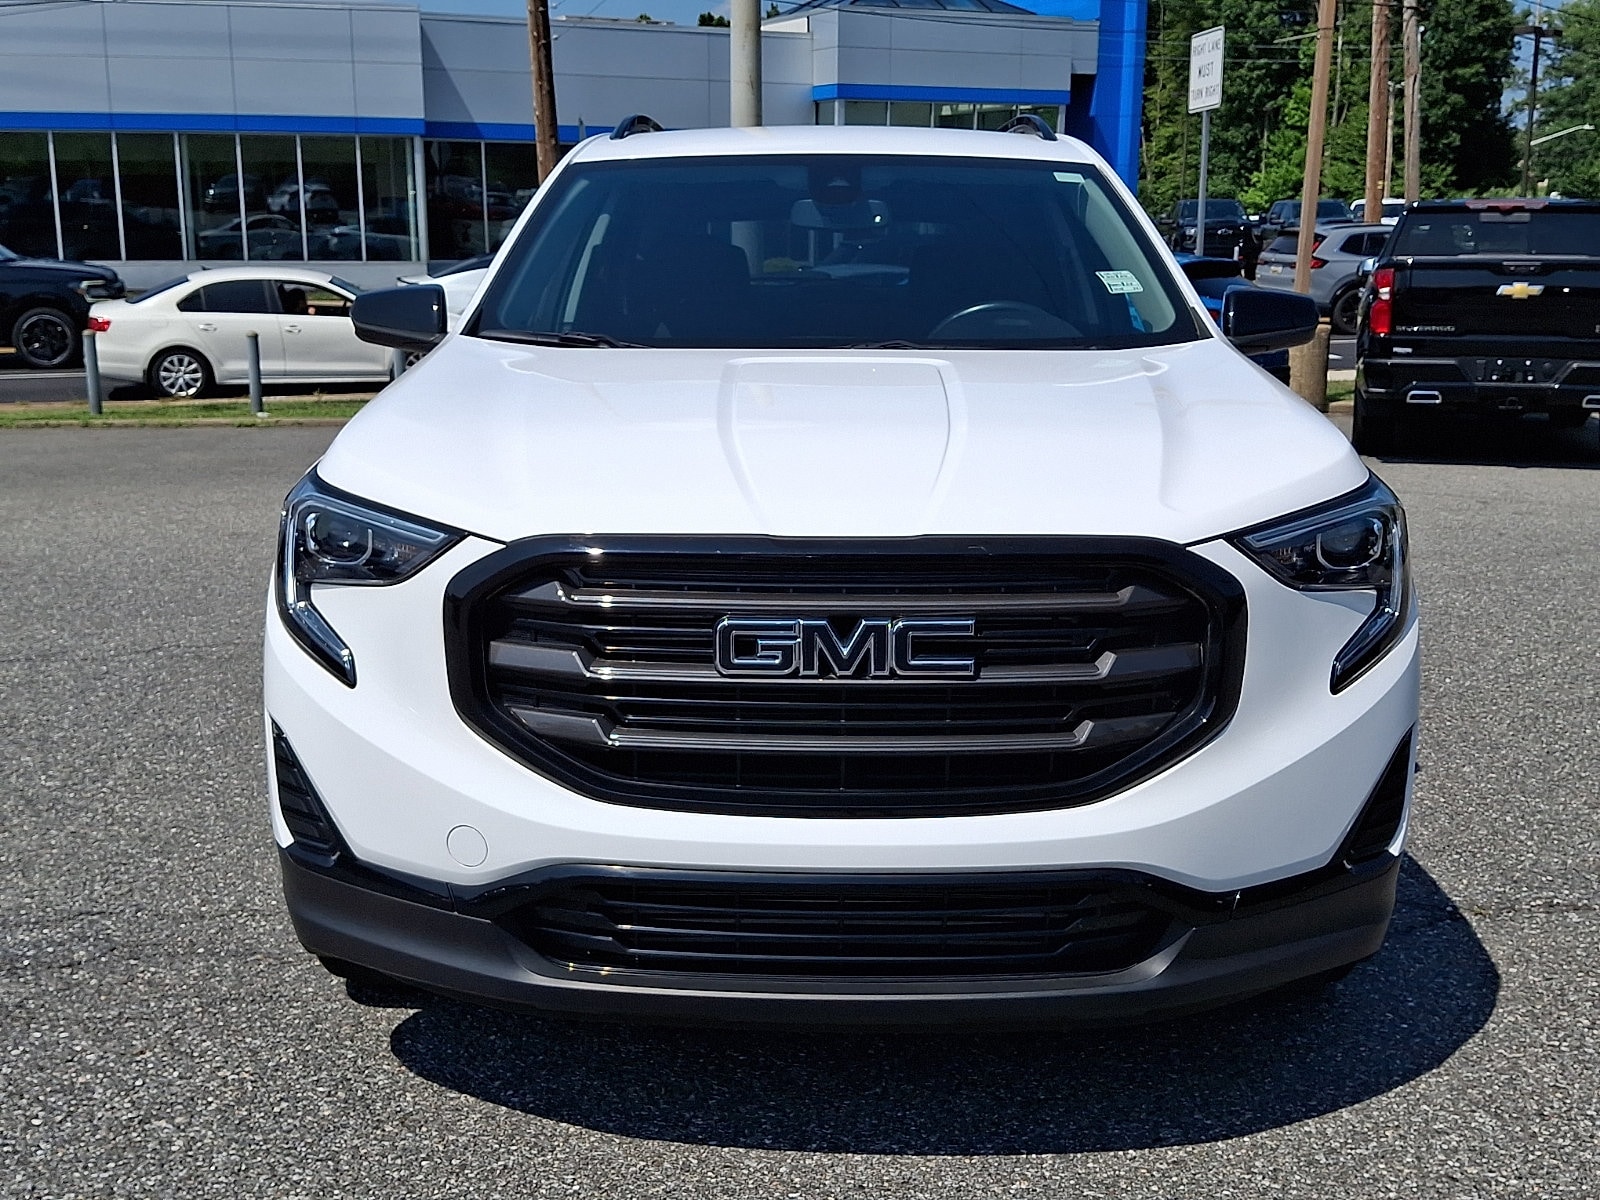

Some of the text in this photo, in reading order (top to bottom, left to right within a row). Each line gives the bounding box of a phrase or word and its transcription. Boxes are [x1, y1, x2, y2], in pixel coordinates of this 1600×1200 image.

[1192, 42, 1207, 57] RIGHT
[1197, 61, 1214, 78] MUST
[714, 613, 977, 678] GMC
